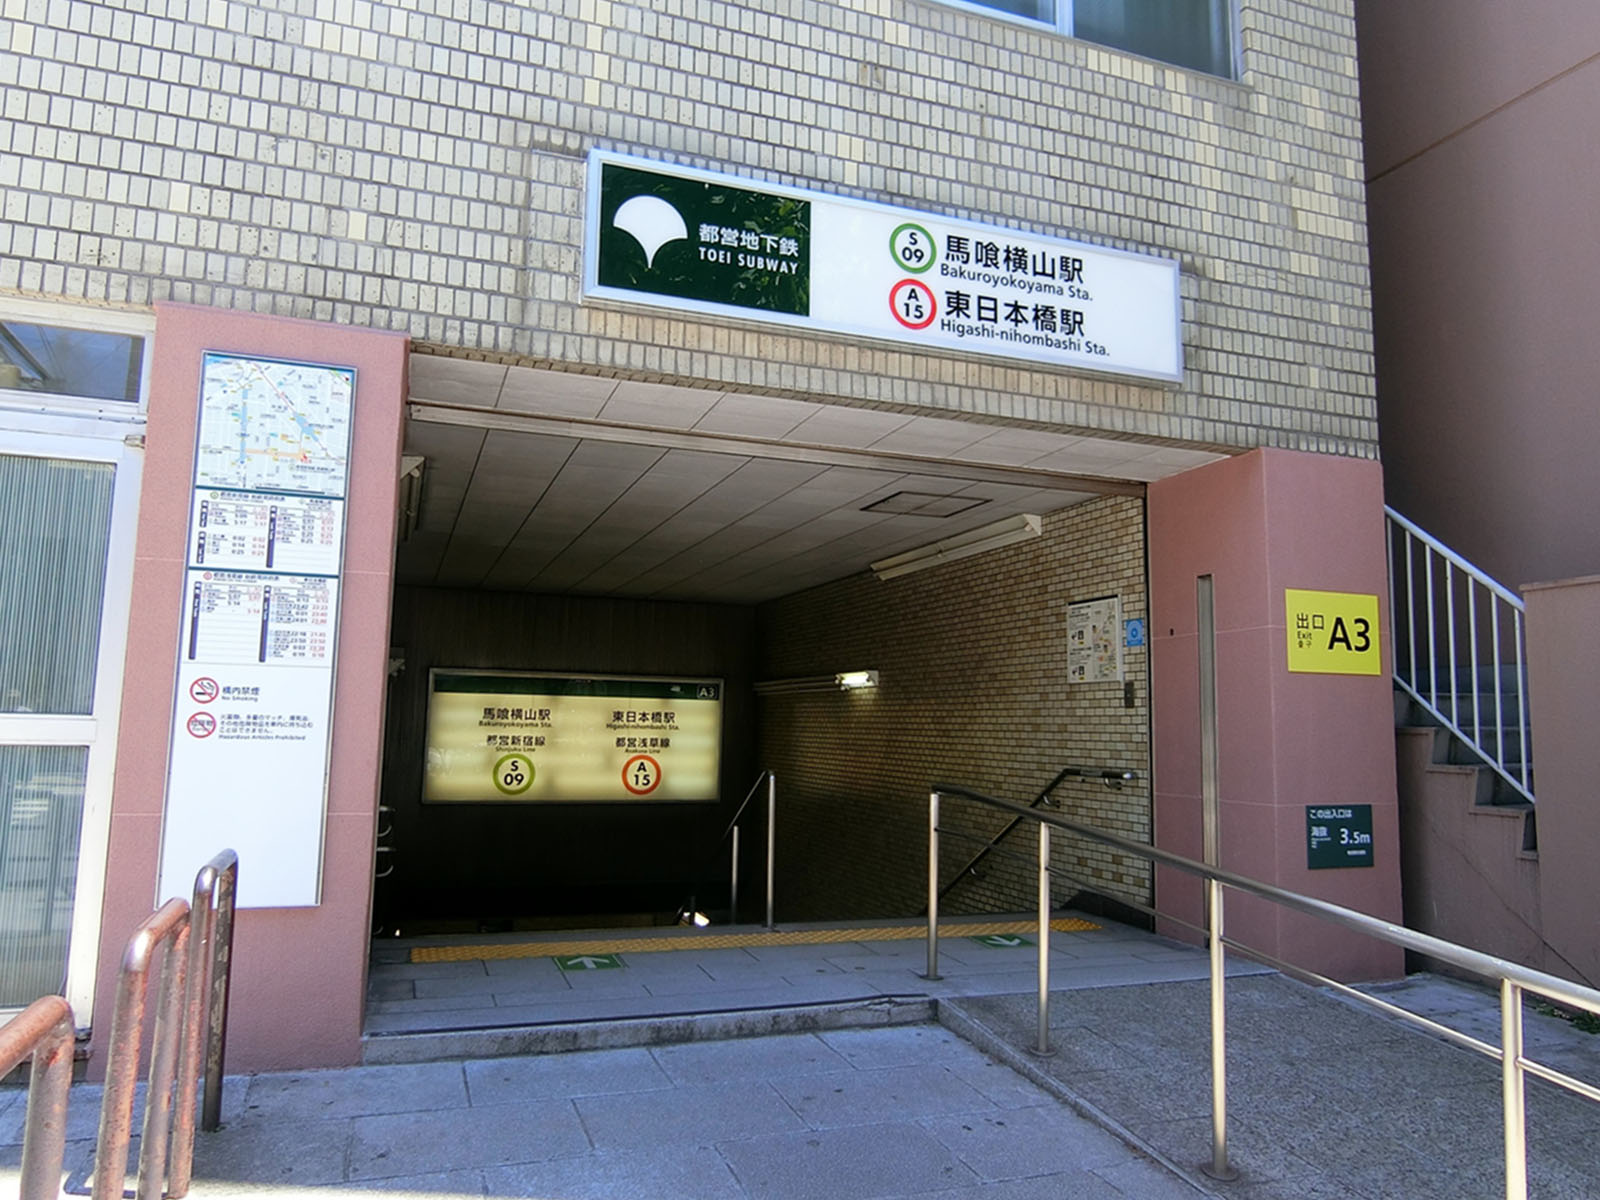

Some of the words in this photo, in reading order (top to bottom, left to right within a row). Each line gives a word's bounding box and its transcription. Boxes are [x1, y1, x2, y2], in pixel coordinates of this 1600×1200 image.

[699, 223, 799, 257] 都営地下鉄
[908, 231, 919, 246] S
[699, 247, 731, 264] TOEI
[738, 253, 798, 275] SUBWAY
[902, 246, 925, 264] 09
[945, 234, 1084, 284] 馬喰横山駅
[940, 263, 1064, 296] Bakuroyokoyama
[1068, 286, 1094, 302] Sta.
[907, 287, 919, 302] A
[903, 302, 924, 319] 15
[944, 289, 1085, 337] 東日本橋駅
[940, 319, 1081, 351] Higashi-nihombashi
[1085, 340, 1110, 356] Sta.
[1296, 612, 1324, 630] 出口
[1327, 616, 1371, 652] A3
[699, 687, 715, 698] A3
[482, 707, 552, 721] 馬喰横山駅
[612, 710, 676, 723] 東日本橋駅
[487, 734, 545, 747] 都営新宿線
[616, 737, 670, 748] 都営浅草線
[510, 760, 519, 772] S
[637, 761, 647, 772] A
[503, 772, 524, 786] 09
[634, 774, 651, 786] 15
[1340, 828, 1371, 845] 3.5m
